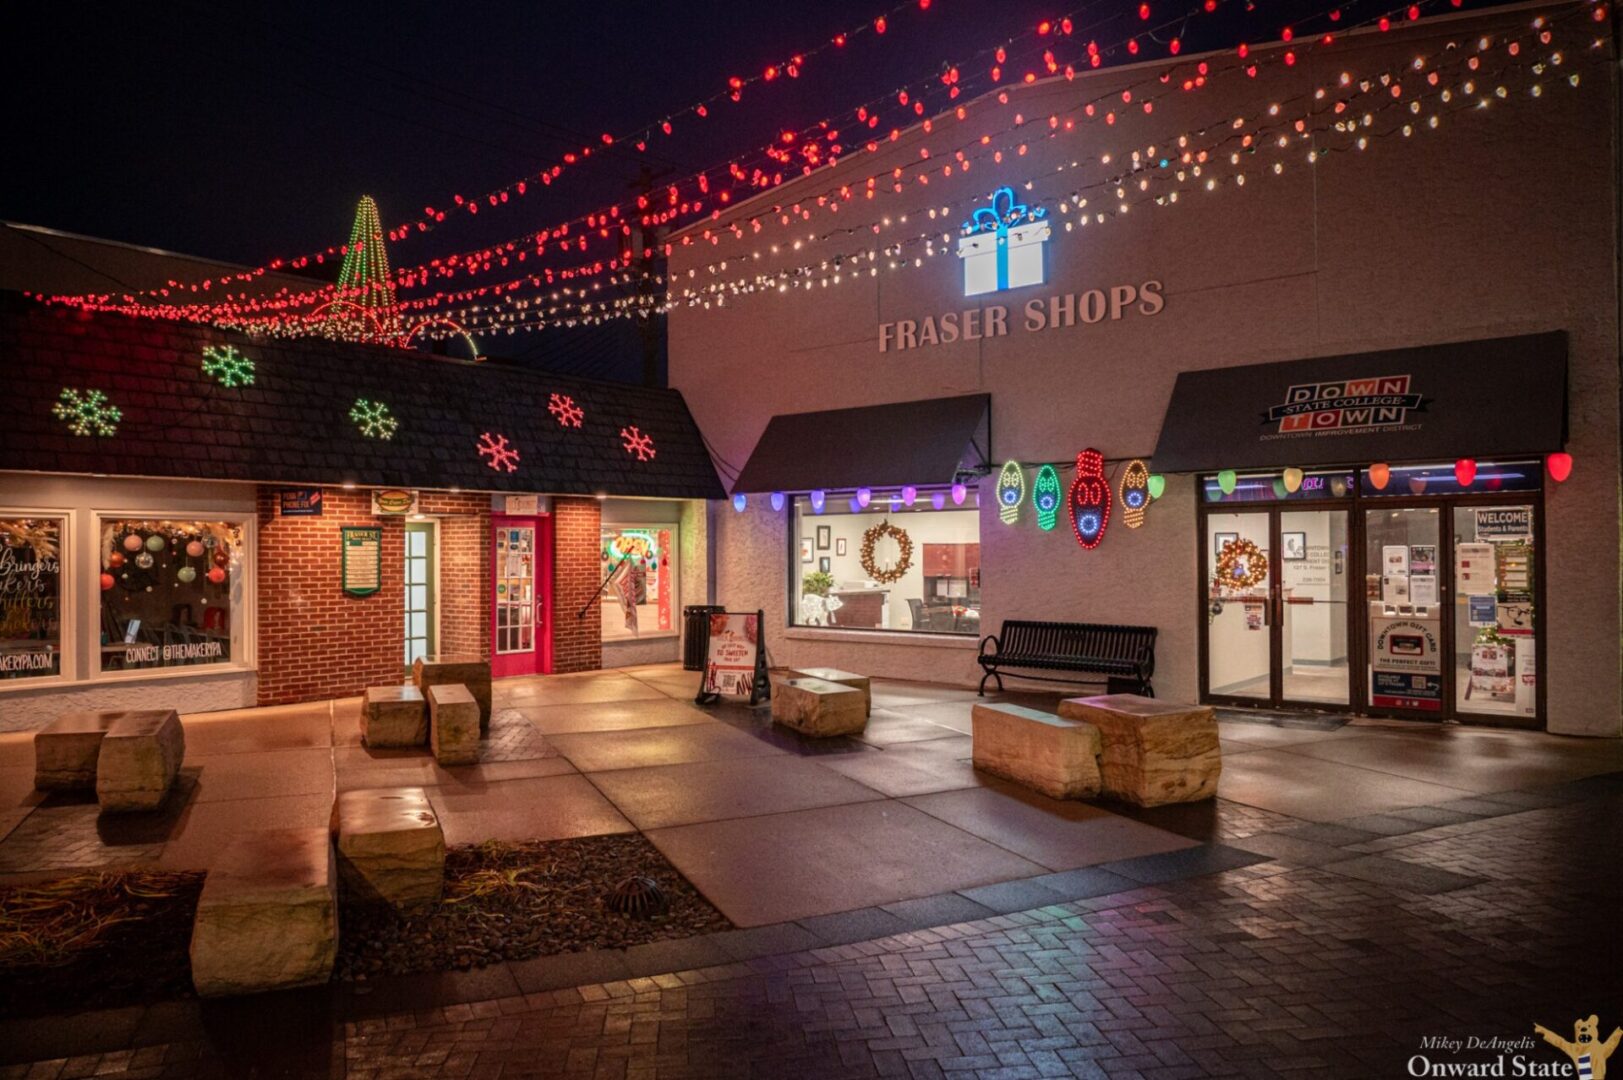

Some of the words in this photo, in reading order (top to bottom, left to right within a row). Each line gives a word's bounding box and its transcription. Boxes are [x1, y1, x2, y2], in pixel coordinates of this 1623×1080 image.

[878, 305, 1008, 353] FRASER
[1024, 280, 1166, 332] SHOPS
[1294, 380, 1402, 402] DOWN
[1286, 400, 1331, 415] STATE
[1333, 396, 1402, 408] COLLEGE
[1288, 408, 1398, 428] TOWN
[1259, 431, 1313, 441] DOWNTOWN
[1314, 427, 1380, 438] IMPROVEMENT
[1382, 423, 1423, 433] DISTRICT
[1477, 511, 1528, 524] WELCOME
[615, 536, 649, 557] OPEN
[1377, 621, 1409, 650] DOWNTOWN
[1409, 622, 1427, 632] GIFT
[1425, 632, 1437, 652] CARD
[126, 645, 160, 662] CONNECT
[163, 642, 223, 660] @THEMAKERYPA
